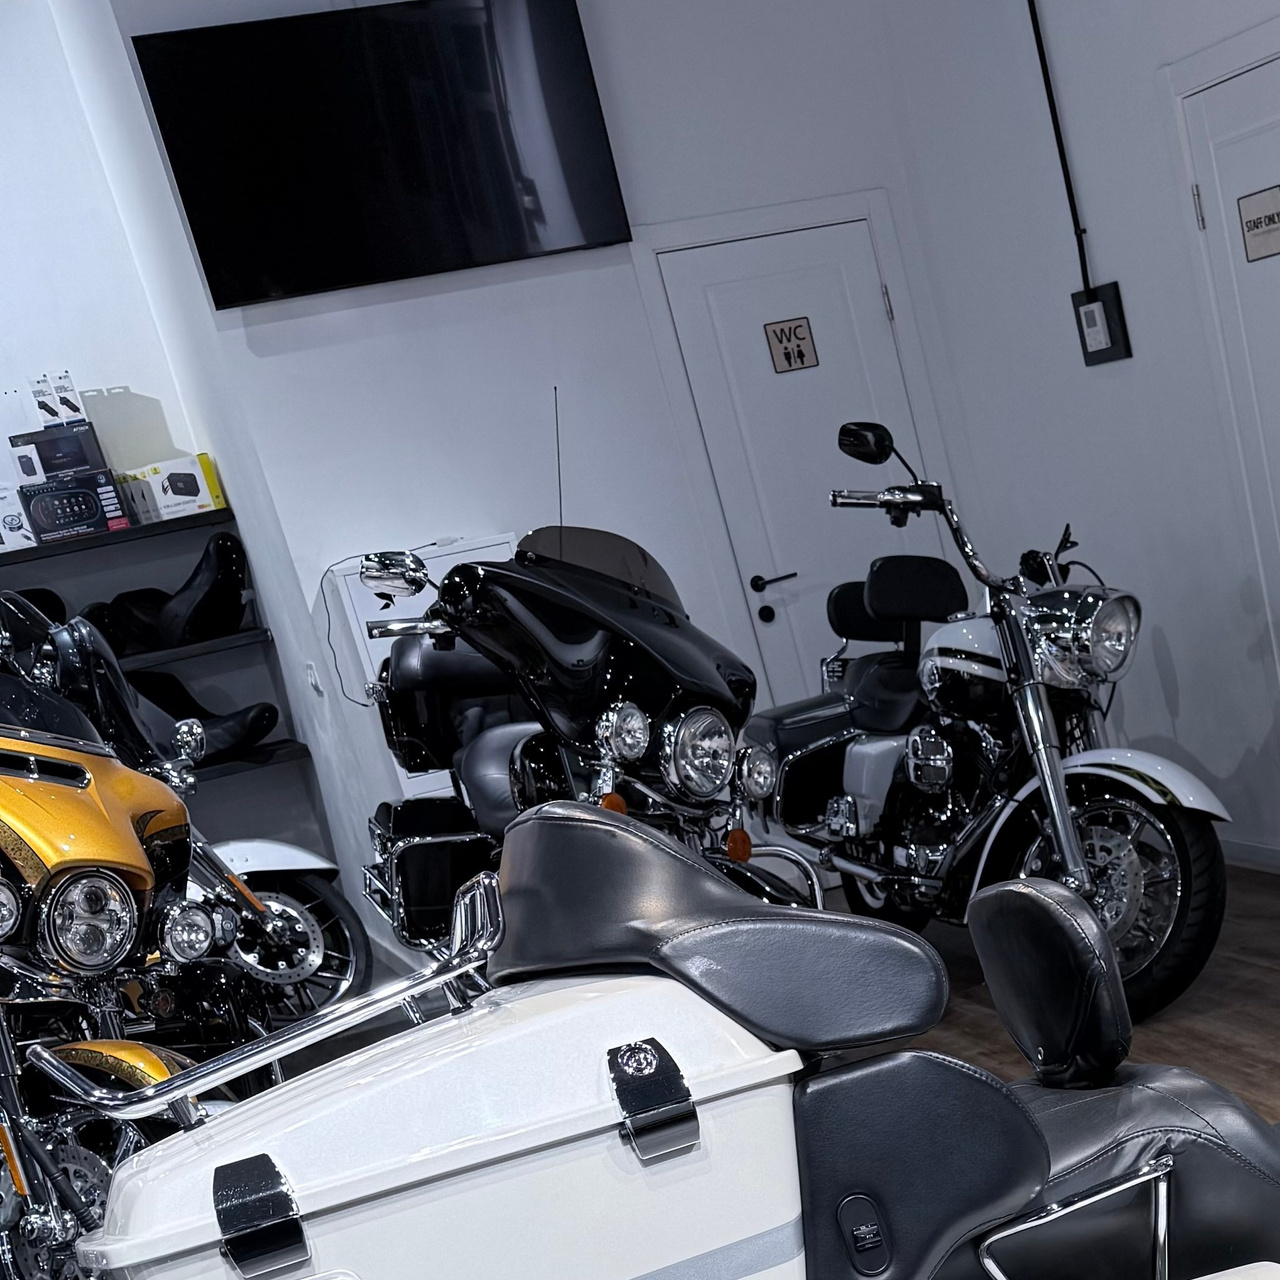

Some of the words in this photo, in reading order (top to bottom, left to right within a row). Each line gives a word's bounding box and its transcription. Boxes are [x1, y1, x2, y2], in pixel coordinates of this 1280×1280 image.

[1245, 216, 1263, 232] STAFF
[1263, 211, 1280, 227] ONLY
[773, 324, 806, 344] WC
